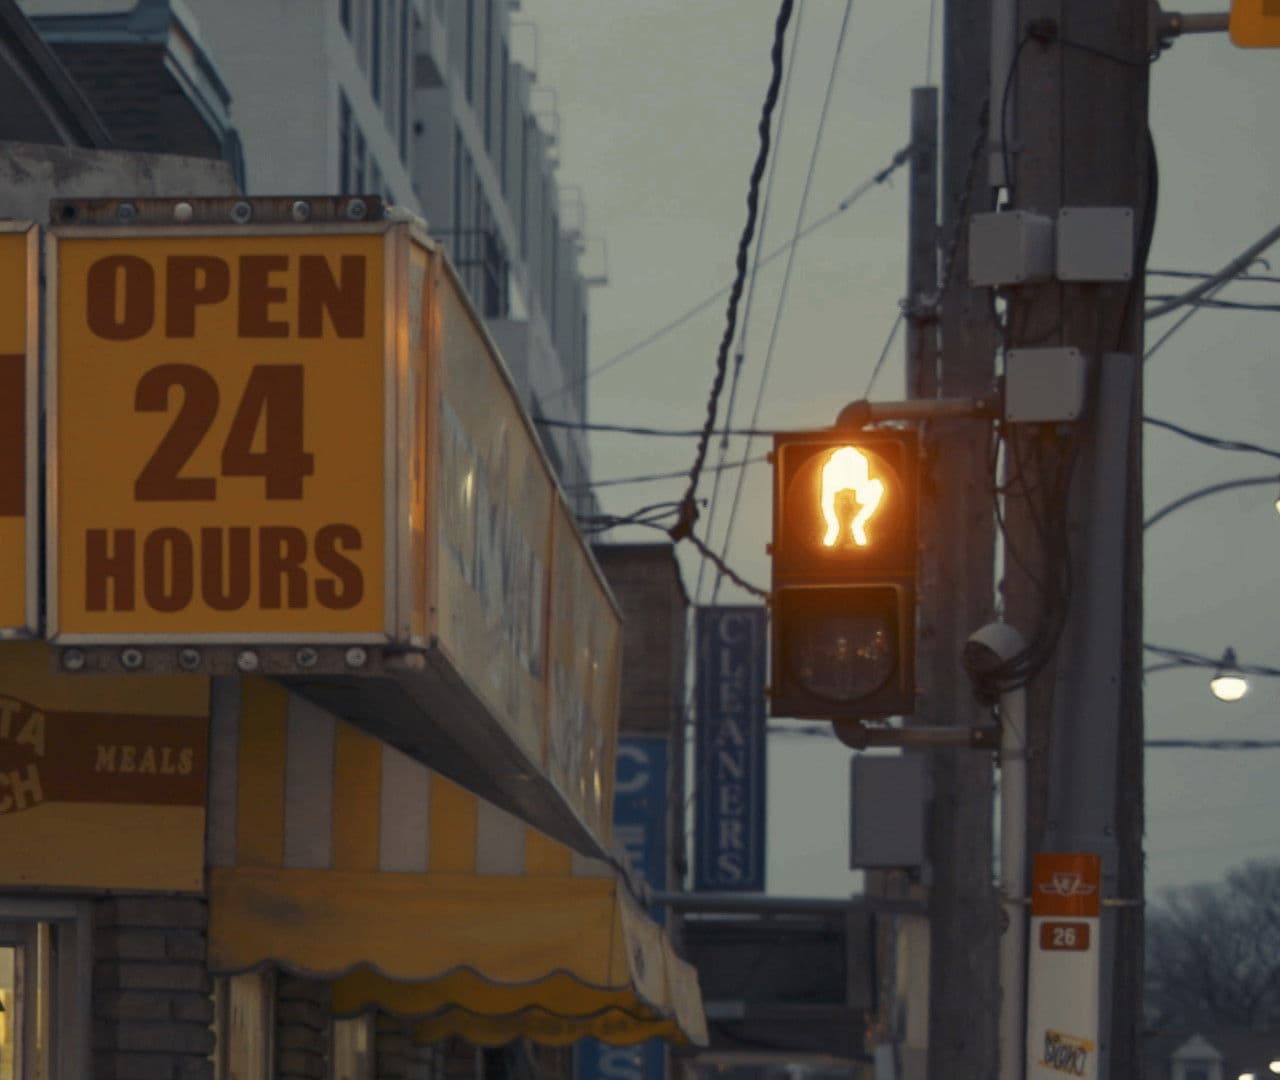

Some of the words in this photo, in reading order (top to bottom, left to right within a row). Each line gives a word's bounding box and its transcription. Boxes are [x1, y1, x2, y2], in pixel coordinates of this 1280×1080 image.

[86, 254, 366, 341] OPEN
[133, 364, 315, 501] 24
[85, 524, 364, 612] HOURS
[94, 744, 194, 776] MEALS
[718, 615, 746, 882] CLEANERS
[1053, 927, 1076, 947] 26
